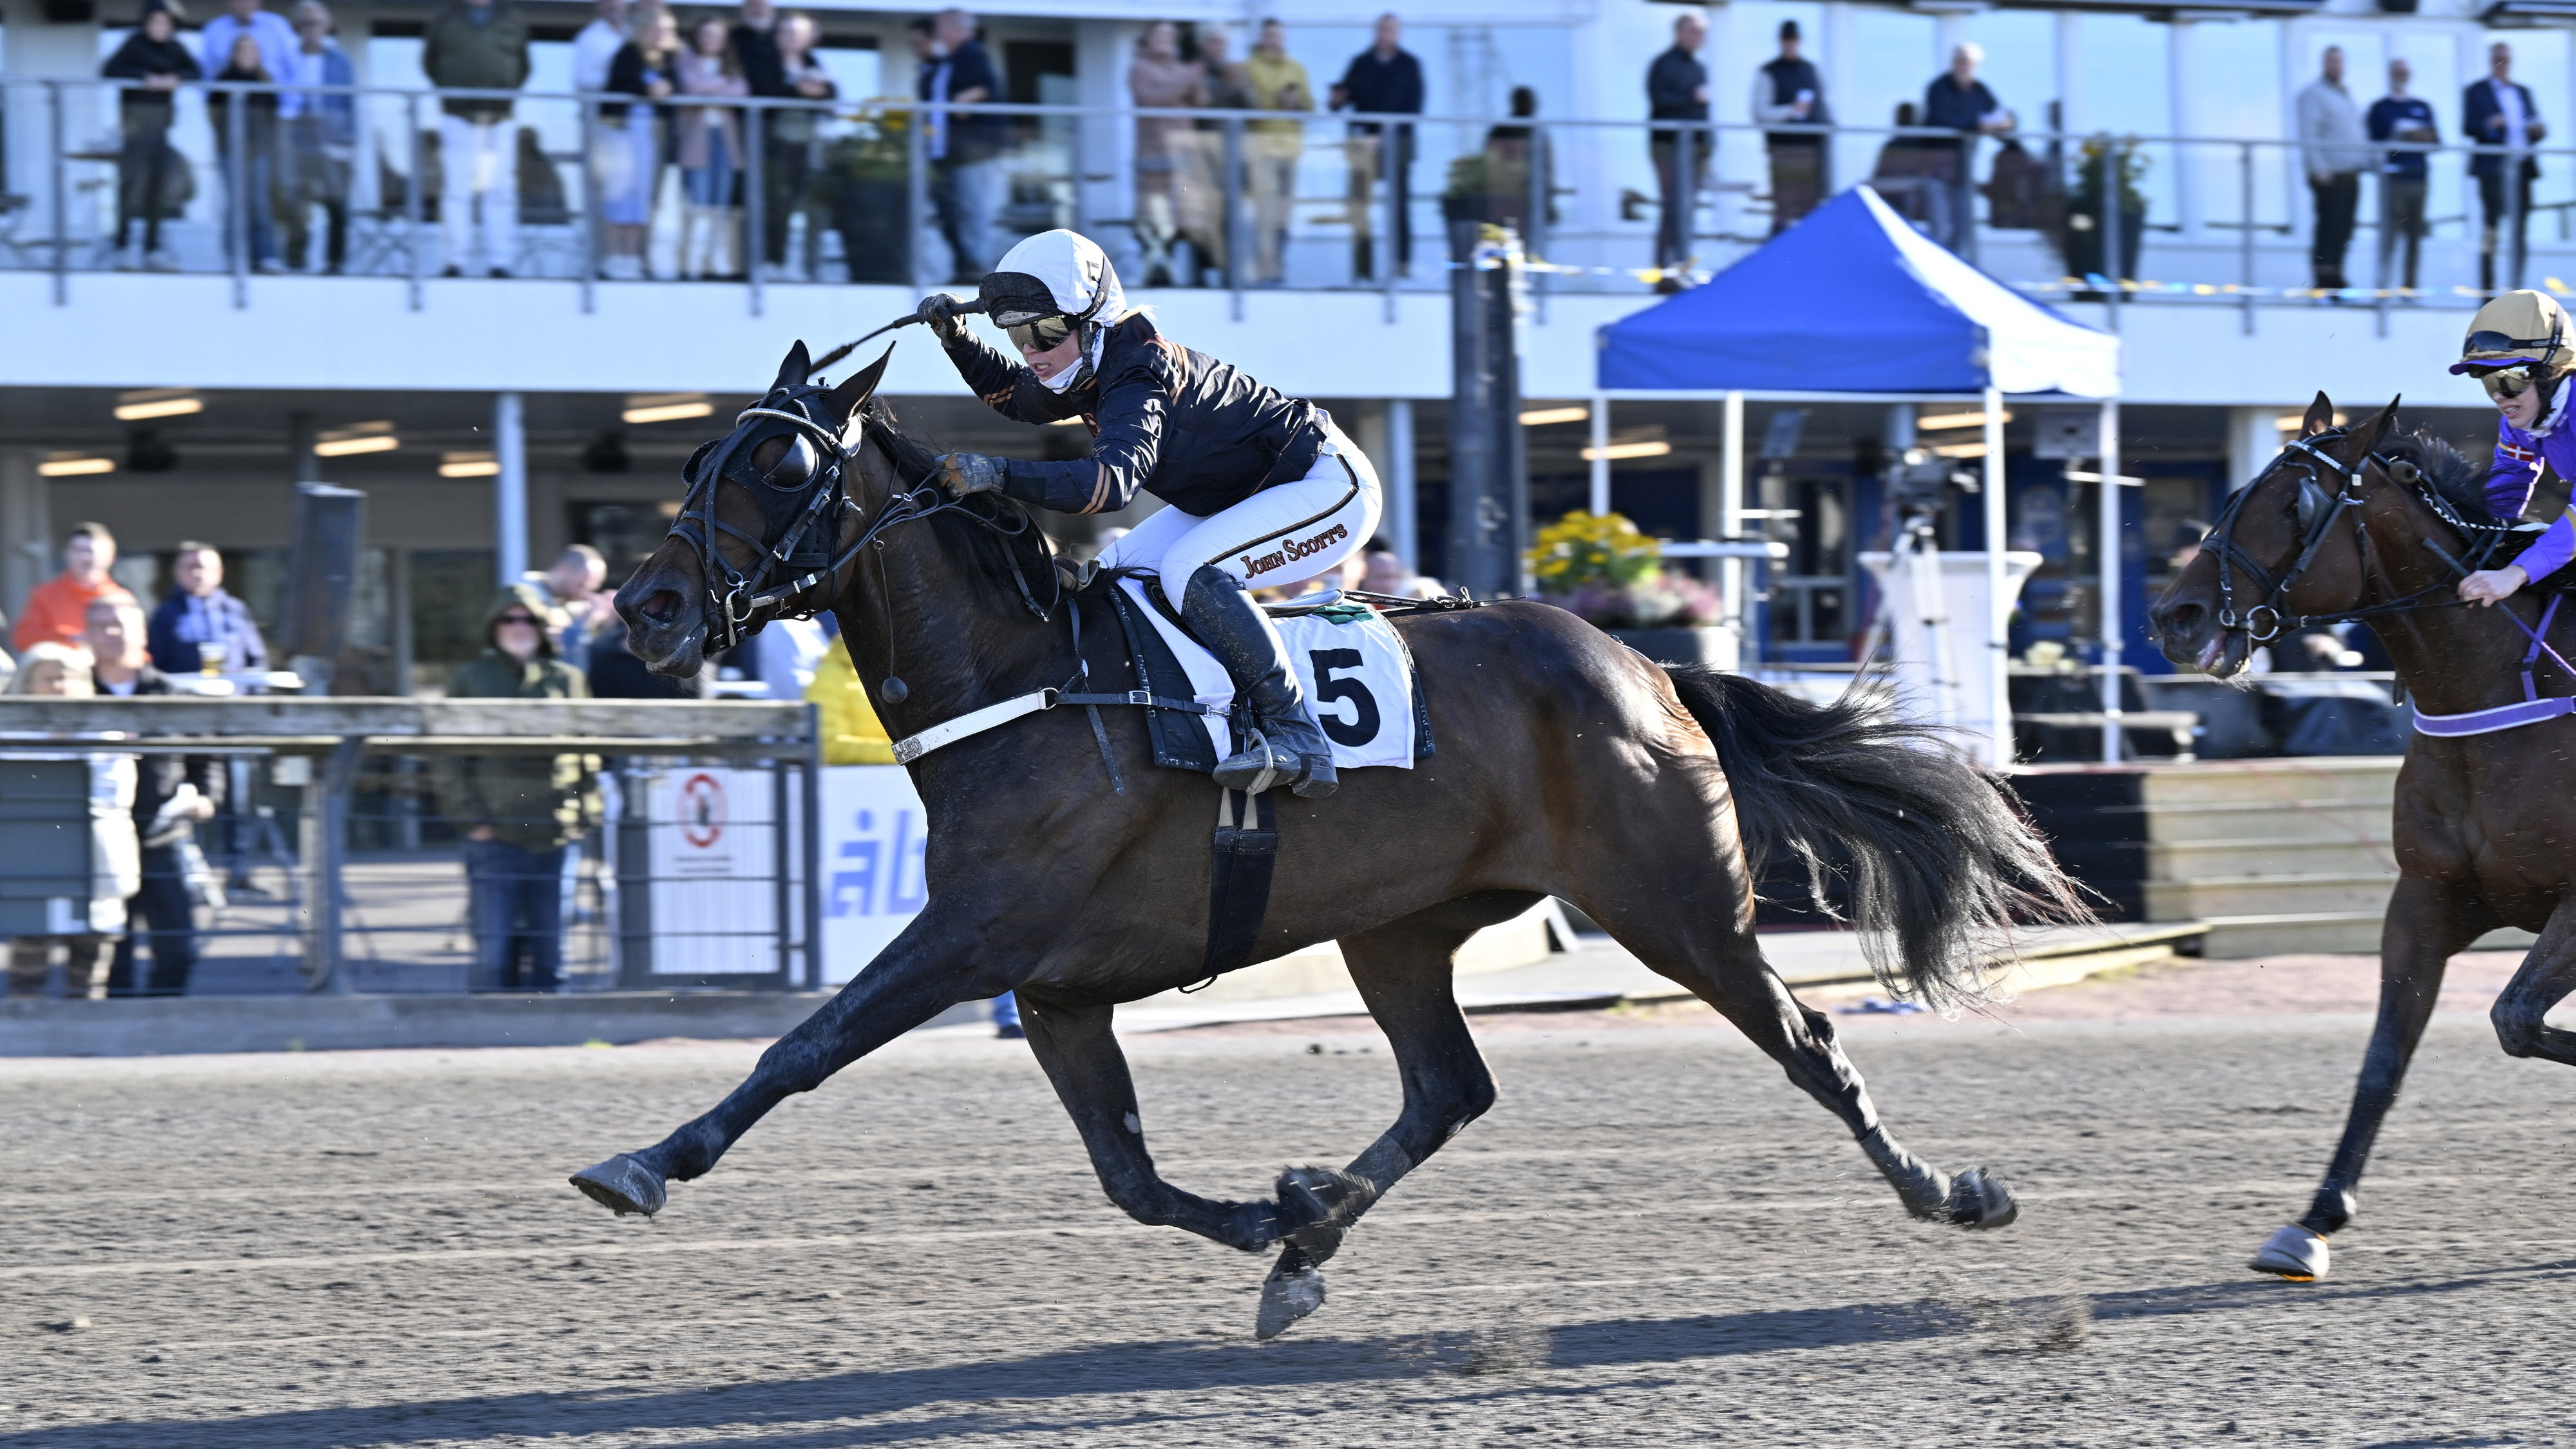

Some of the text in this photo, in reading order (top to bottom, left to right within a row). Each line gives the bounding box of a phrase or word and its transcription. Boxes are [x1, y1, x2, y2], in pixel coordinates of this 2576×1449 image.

[1240, 524, 1348, 579] JOHN SCOTT'S
[1309, 648, 1381, 747] 5
